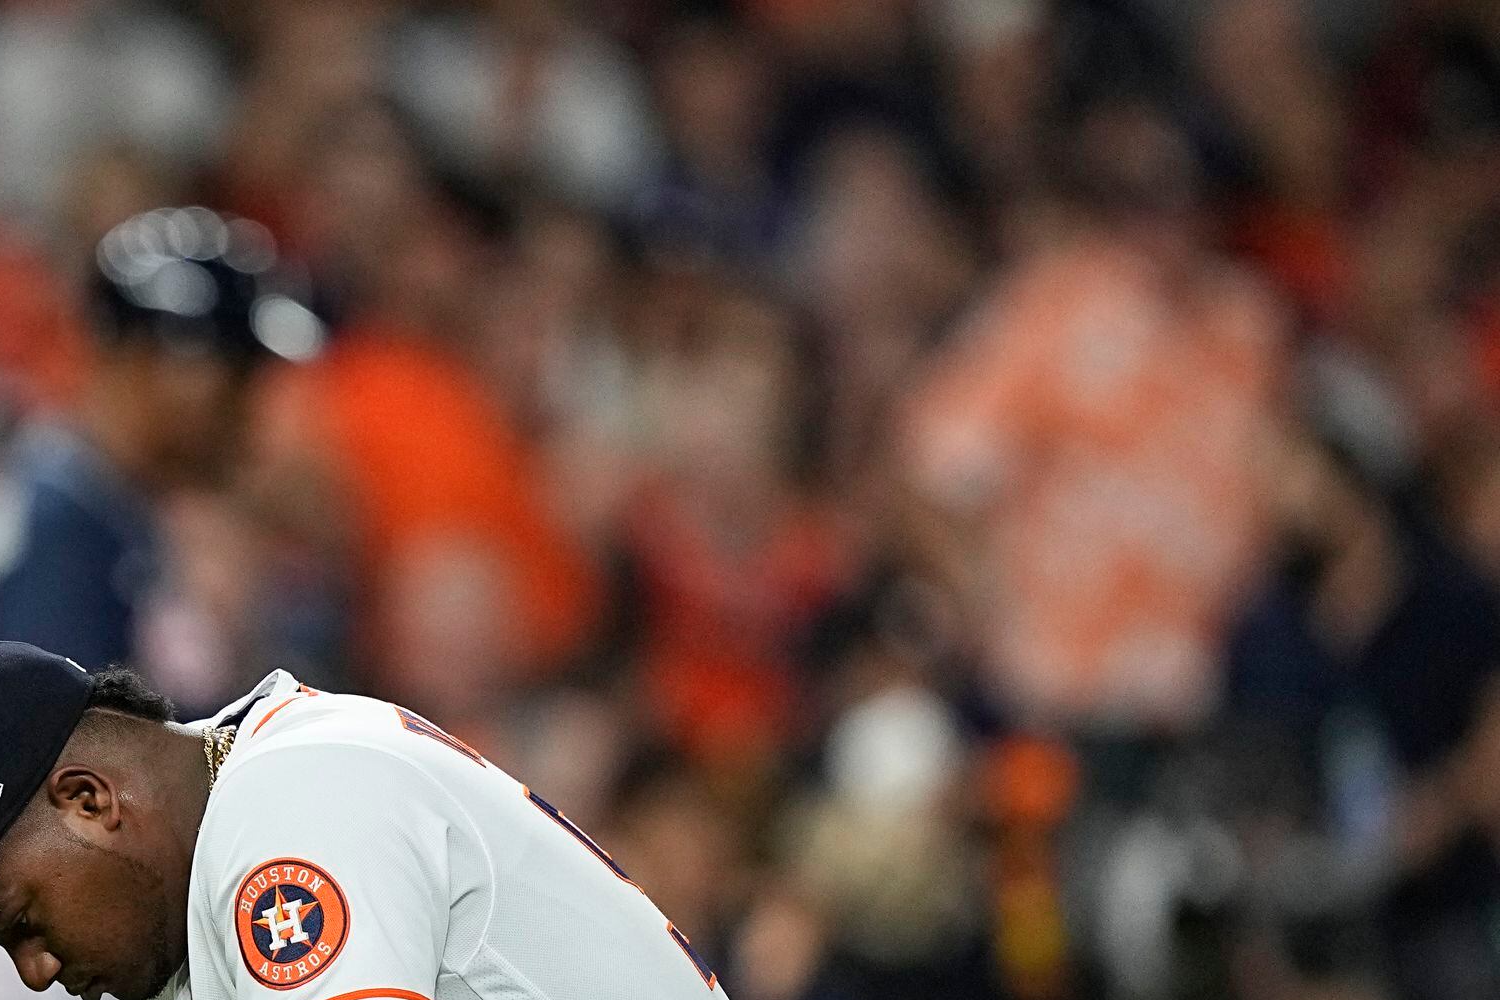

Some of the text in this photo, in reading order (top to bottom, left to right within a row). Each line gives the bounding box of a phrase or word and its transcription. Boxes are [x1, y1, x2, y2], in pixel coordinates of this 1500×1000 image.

[240, 866, 325, 914] HOUSTON
[261, 898, 309, 951] H
[259, 941, 332, 981] ASTROS
